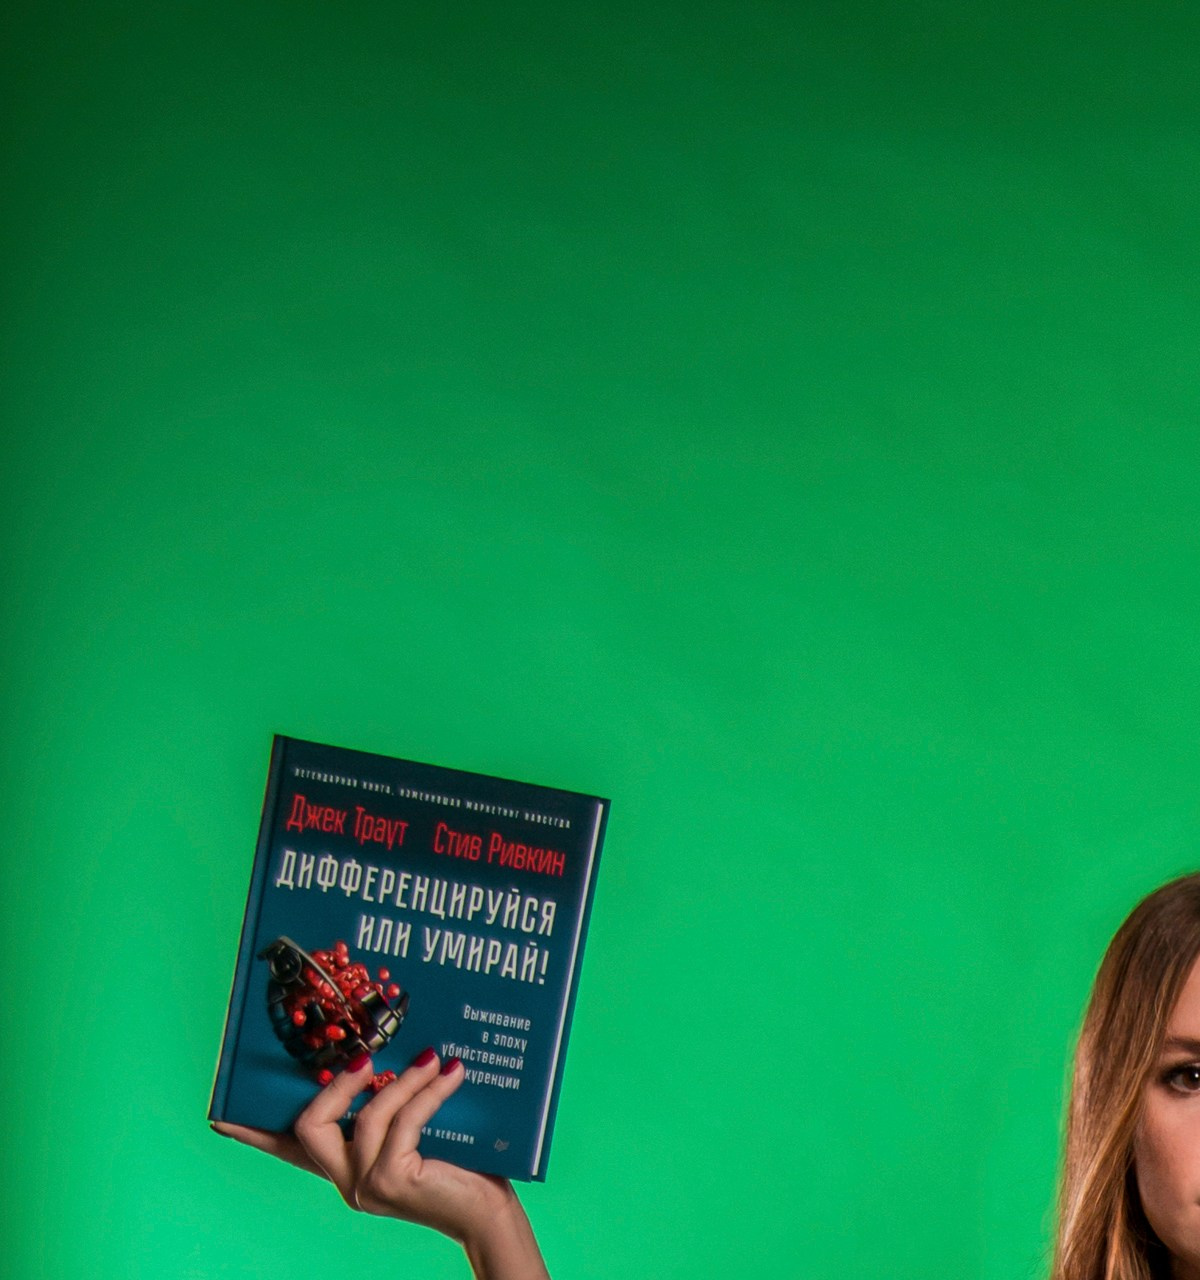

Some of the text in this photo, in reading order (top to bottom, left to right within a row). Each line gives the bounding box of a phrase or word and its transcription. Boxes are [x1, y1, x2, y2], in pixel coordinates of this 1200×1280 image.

[287, 794, 565, 876] Джек Траут Стив Ривкин
[276, 850, 556, 936] ДИФФЕРЕНЦИРУЙСЯ
[356, 915, 549, 985] ИЛИ УМИРАЙ!
[464, 1005, 531, 1031] Выживание
[482, 1032, 527, 1053] в эпоху
[442, 1043, 523, 1070] убийственной
[465, 1069, 520, 1089] куренции
